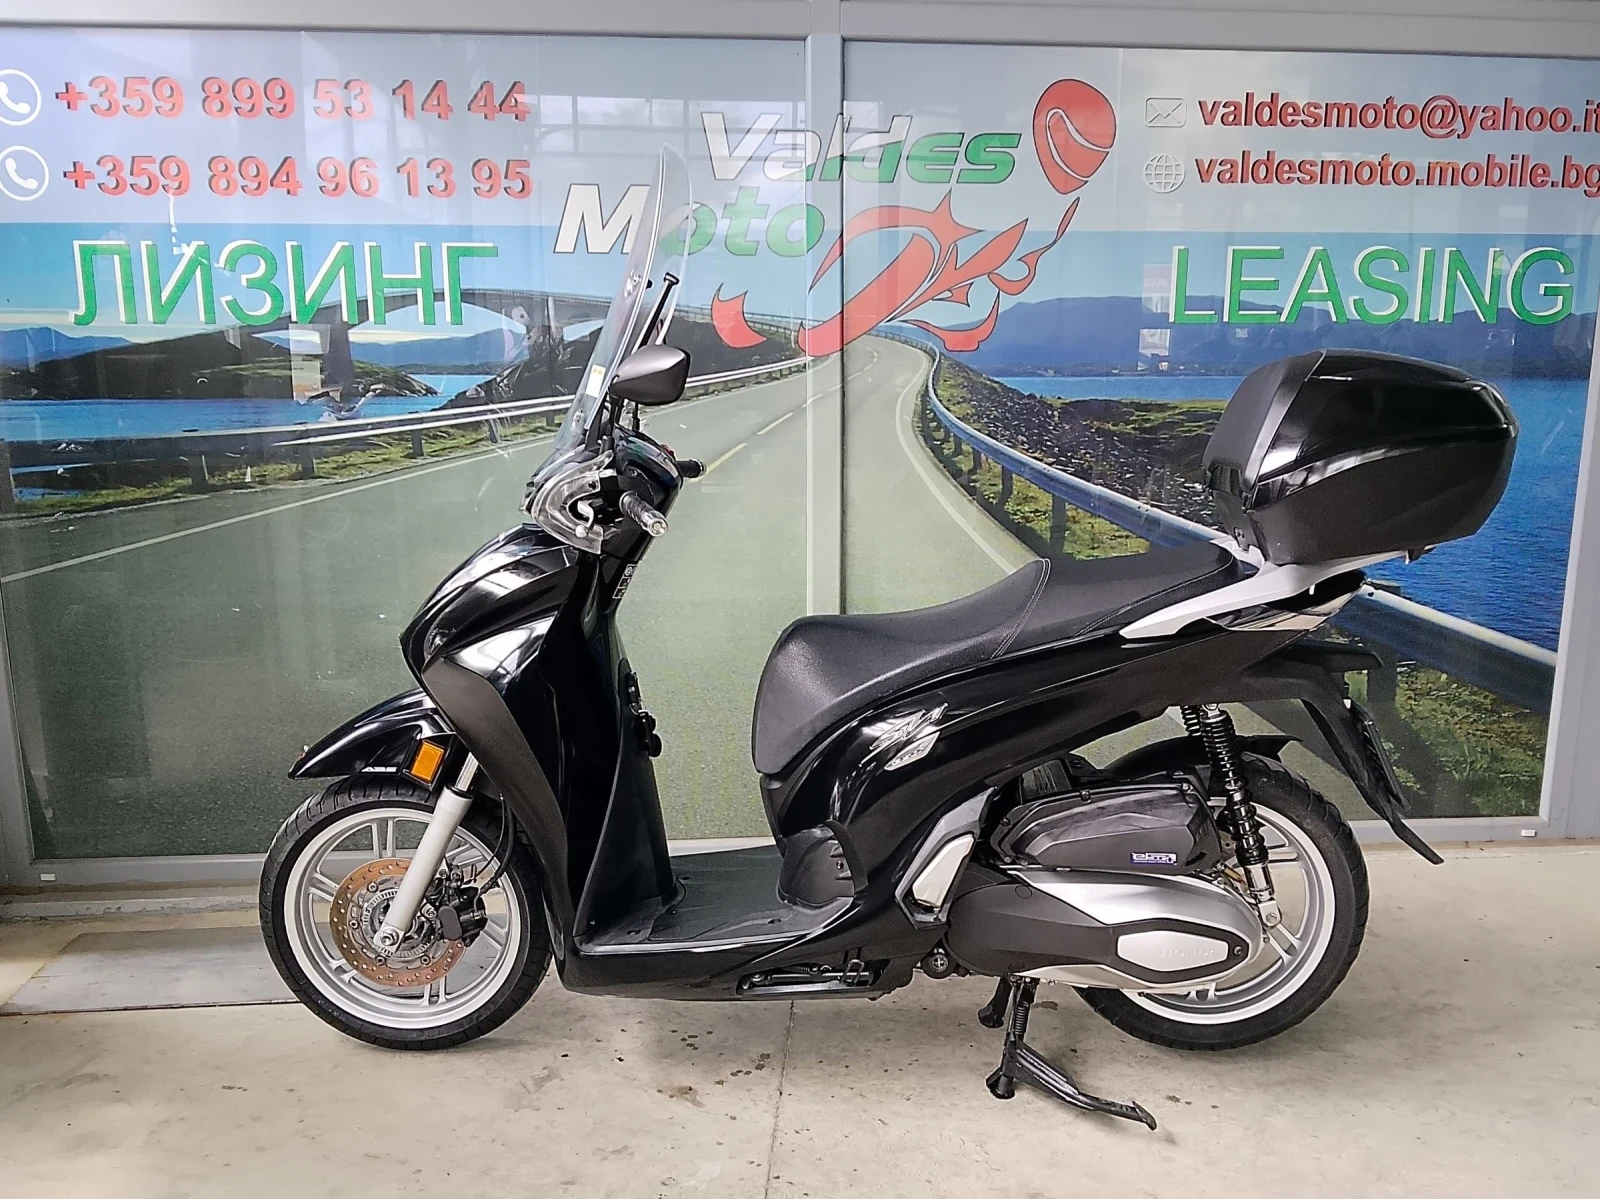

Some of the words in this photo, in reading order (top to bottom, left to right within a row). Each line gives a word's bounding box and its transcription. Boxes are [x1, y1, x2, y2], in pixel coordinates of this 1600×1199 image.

[55, 76, 184, 119] +359
[201, 76, 296, 120] 899
[312, 78, 375, 121] 53
[390, 79, 453, 122] 14
[467, 80, 531, 122] 44
[63, 155, 191, 197] +359
[207, 155, 302, 197] 894
[317, 157, 380, 198] 96
[397, 157, 456, 199] 13
[472, 158, 533, 199] 95
[701, 112, 1022, 184] Valdes
[1195, 150, 1600, 198] valdesmoto.mobile.bg
[553, 183, 825, 258] Moto
[69, 239, 499, 326] ЛИЗИНГ
[1169, 245, 1574, 325] LEASING
